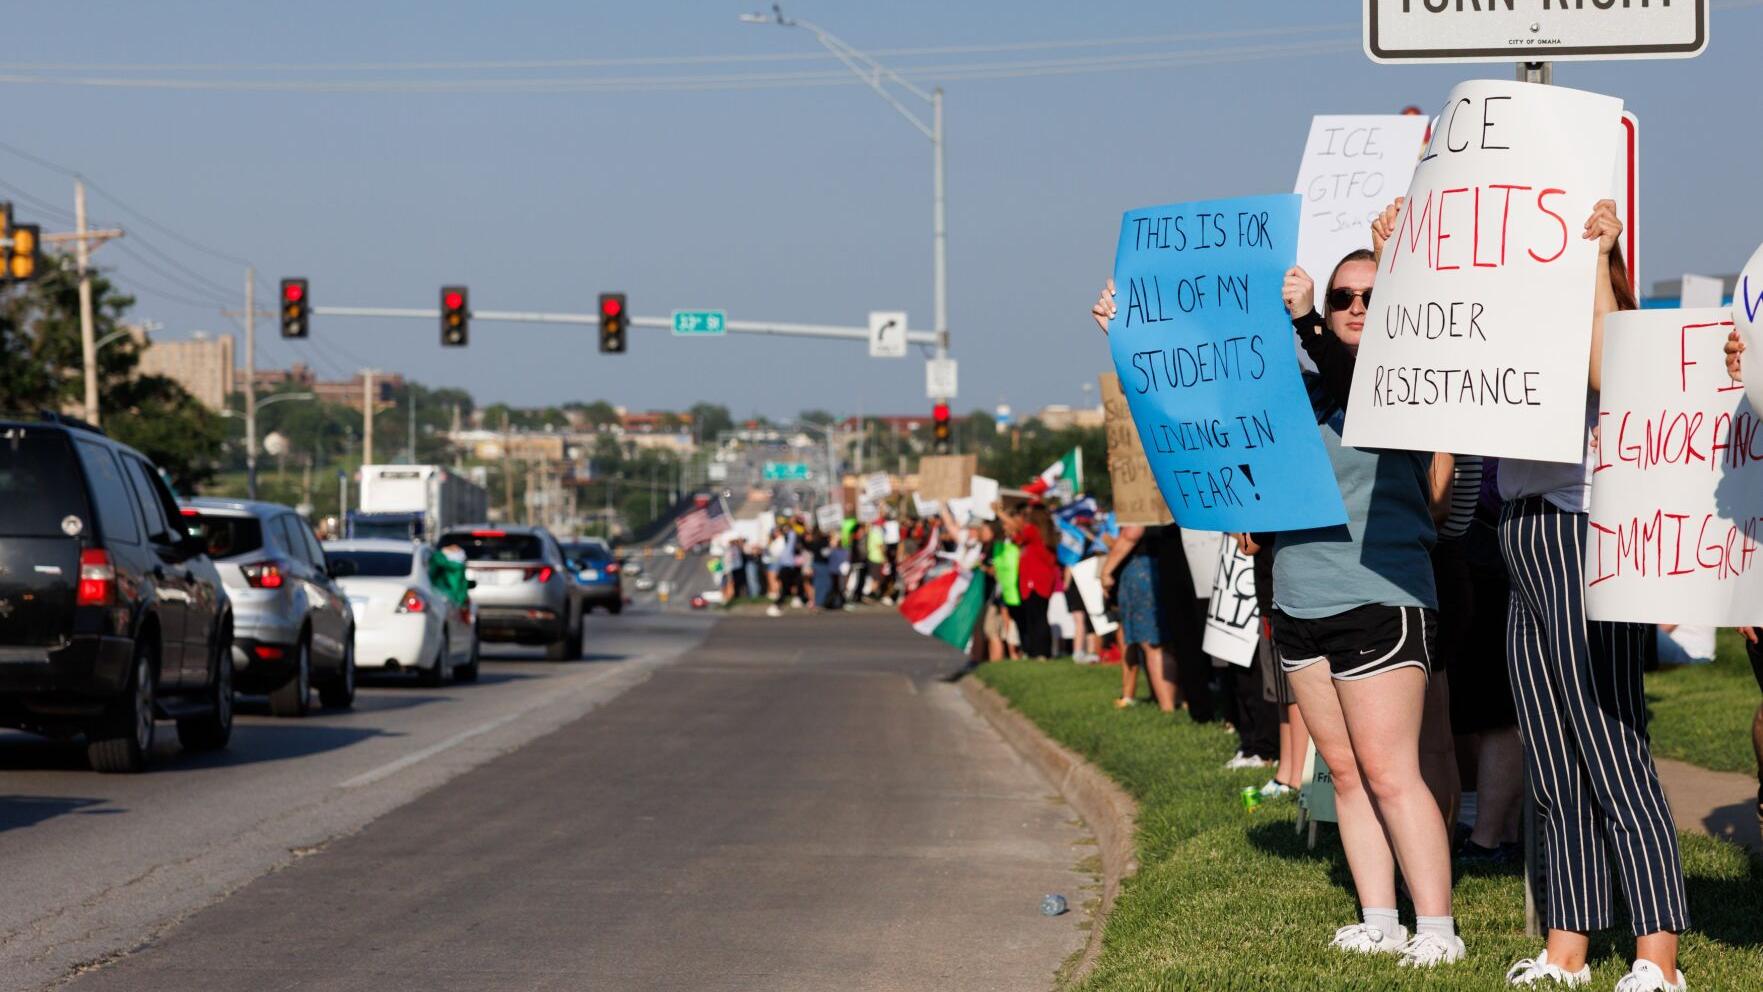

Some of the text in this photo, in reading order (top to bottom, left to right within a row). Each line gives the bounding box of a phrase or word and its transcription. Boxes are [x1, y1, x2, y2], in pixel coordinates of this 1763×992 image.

[1307, 171, 1385, 202] GTFO
[1132, 215, 1187, 251] THIS
[1193, 213, 1226, 250] IS
[1238, 211, 1273, 250] FOR
[1390, 184, 1568, 274] MELTS
[1126, 274, 1249, 328] ALL OF MY
[1386, 302, 1487, 341] UNDER
[1132, 334, 1265, 395] STUDENTS
[1373, 365, 1541, 407] RESISTANCE
[1149, 419, 1231, 454] LIVING
[1236, 410, 1277, 450] IN
[1173, 463, 1261, 509] FEAR!
[1589, 509, 1763, 587] IMMIGRA
